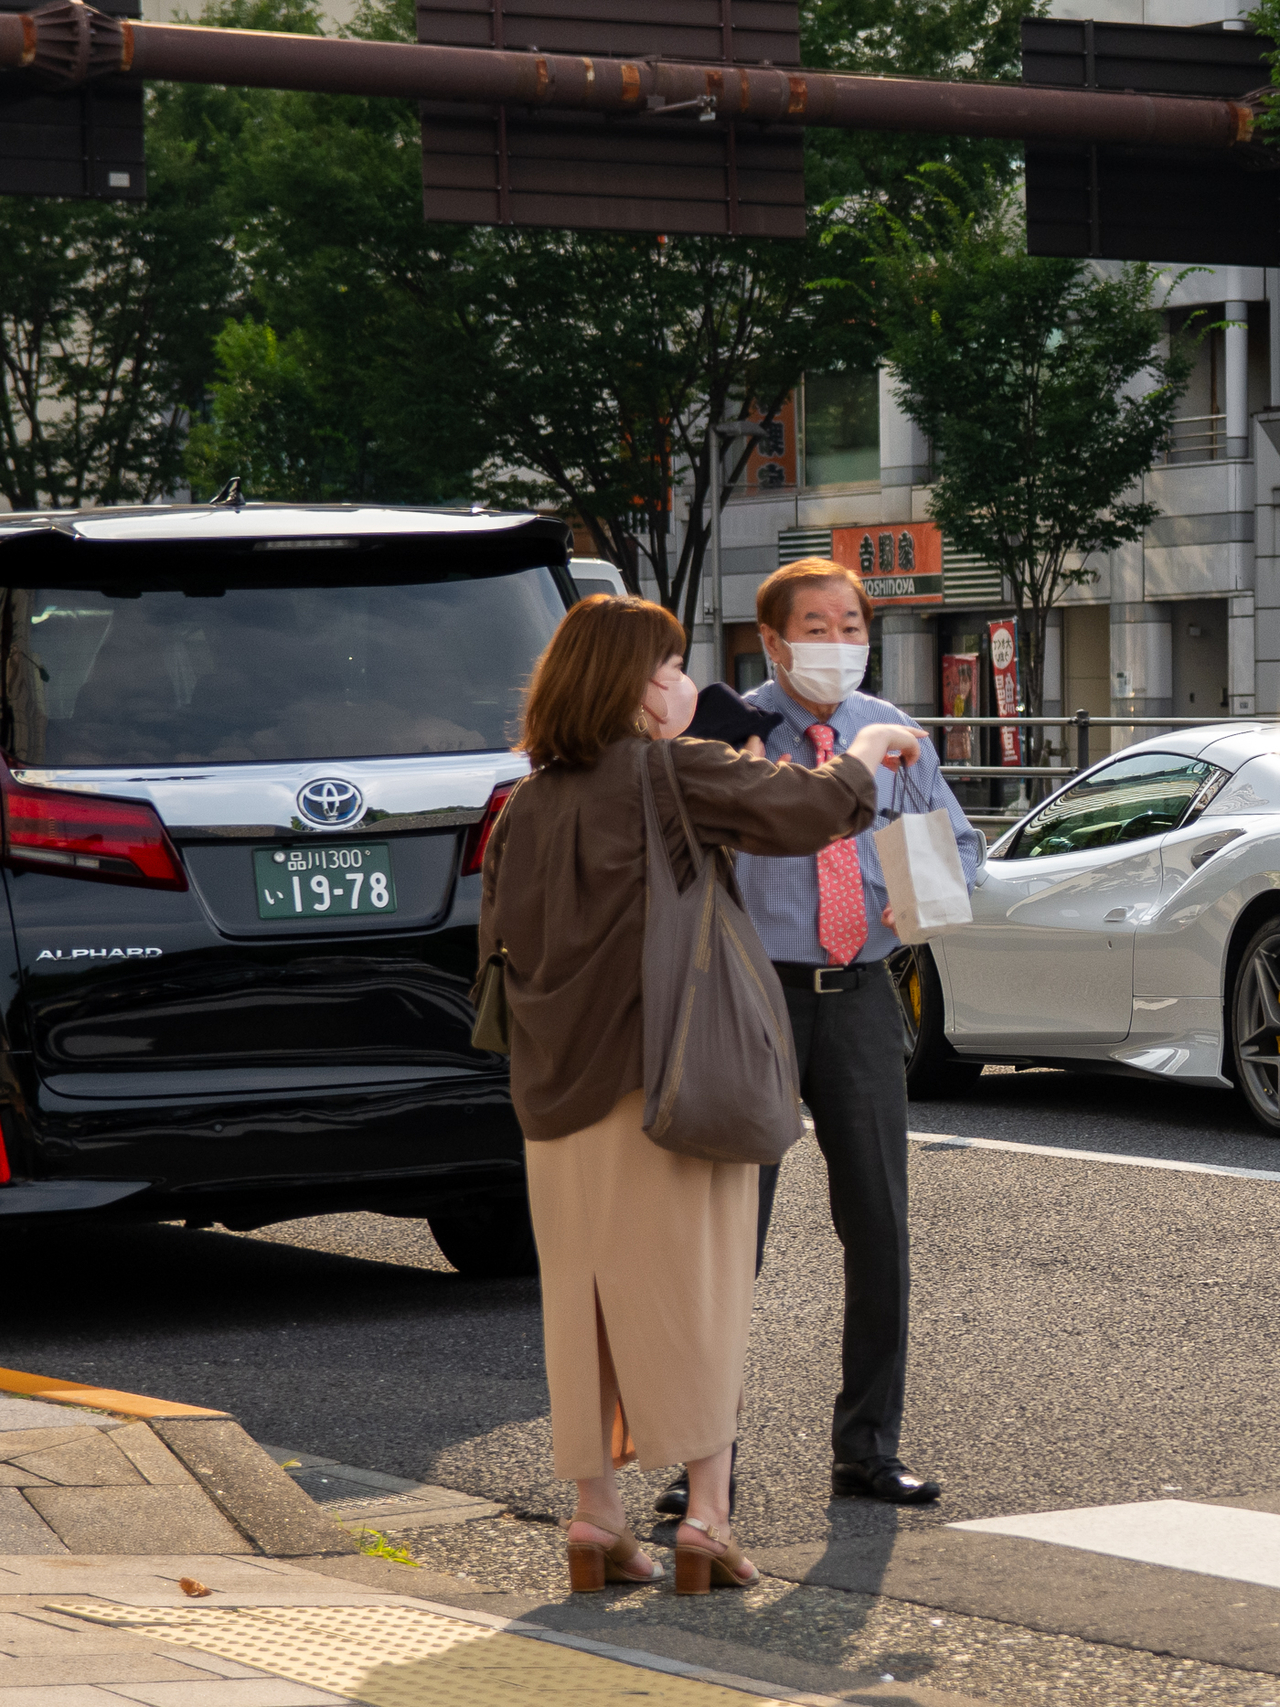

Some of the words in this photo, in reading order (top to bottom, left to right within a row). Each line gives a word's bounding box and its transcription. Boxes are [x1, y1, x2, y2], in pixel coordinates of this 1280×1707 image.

[859, 529, 915, 574] 吉野家
[264, 889, 284, 905] い
[292, 872, 389, 912] 19-78
[36, 947, 163, 961] ALPHARD
